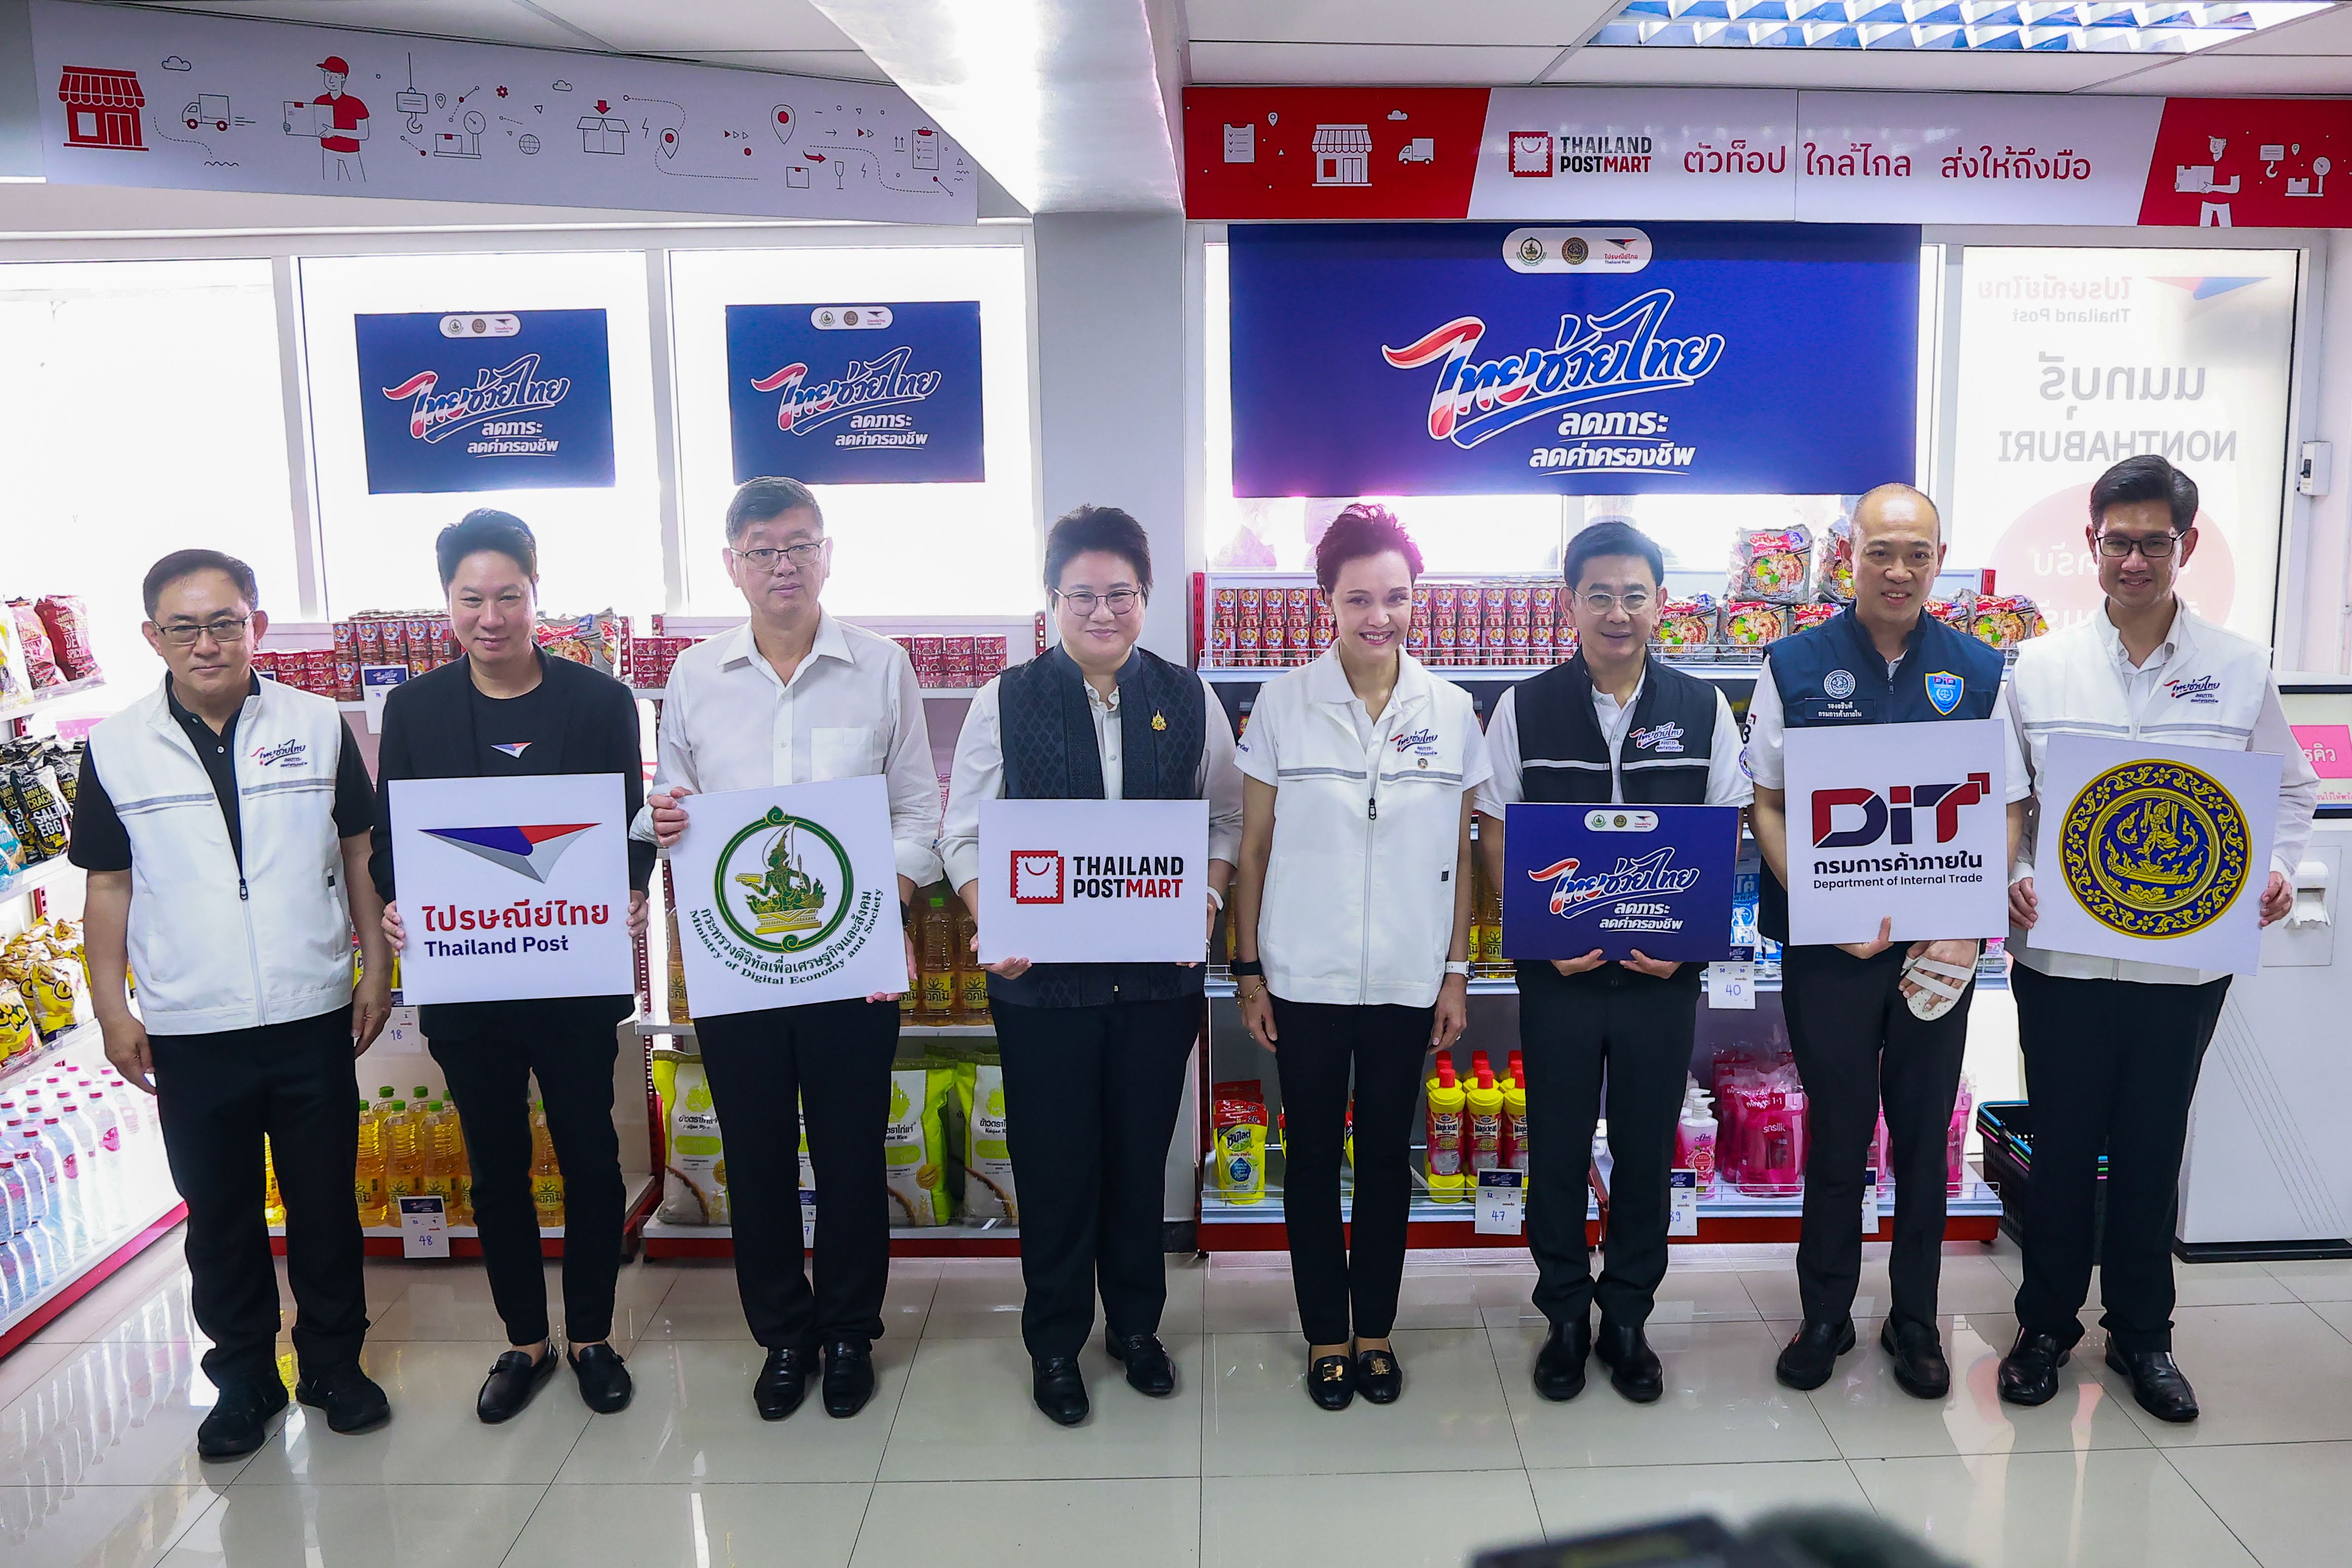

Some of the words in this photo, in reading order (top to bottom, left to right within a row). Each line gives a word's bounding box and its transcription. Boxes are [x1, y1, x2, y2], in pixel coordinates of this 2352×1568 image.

[1561, 136, 1652, 153] THAILAND
[1561, 156, 1652, 172] POSTMART
[1684, 139, 1786, 173] ตัวท็อป
[1803, 142, 1911, 176] ใกล้ไกล
[1941, 145, 2091, 180] ส่งให้ถึงมือ
[1382, 288, 1725, 440] ไทยช่วยไทย
[382, 353, 571, 439] ไทยช่วยไทย
[750, 346, 941, 431] ไทยช่วยไทย
[481, 420, 543, 436] ลดภาระ
[850, 414, 913, 428] ลดภาระ
[1558, 411, 1670, 436] ลดภาระ
[467, 439, 559, 453] ลดค่าครองชีพ
[834, 431, 929, 446] ลดค่าครองชีพ
[1529, 442, 1696, 467] ลดค่าครองชีพ
[37, 820, 63, 837] EGG
[1073, 856, 1184, 875] THAILAND
[1814, 850, 1983, 874] กรมการค้าภายใน
[1073, 878, 1184, 898] POSTMART
[1528, 847, 1700, 914] ไทยช่วยไทย
[1813, 877, 1884, 891] Department
[1887, 876, 1898, 886] of
[1901, 874, 1946, 885] Internal
[1951, 873, 1983, 883] Trade
[422, 899, 609, 932] ไปรษณีย์ไทย
[1614, 902, 1671, 914] ลดภาระ
[1599, 916, 1683, 930] ลดค่าครองชีพ
[690, 909, 723, 960] Ministry
[725, 960, 739, 971] of
[740, 968, 784, 984] Digital
[789, 959, 846, 984] Economy
[848, 937, 866, 959] and
[863, 889, 884, 934] Society
[701, 891, 872, 974] กระทรวงดิจิทัลเพื่อเศรษฐกิจและสังคม
[424, 937, 516, 957] Thailand
[522, 935, 569, 952] Post
[1726, 984, 1741, 997] 40
[391, 1029, 403, 1041] 18
[1435, 1122, 1458, 1132] Magiclean
[1475, 1124, 1497, 1133] Magiclean
[1492, 1210, 1505, 1221] 47
[419, 1235, 433, 1246] 48
